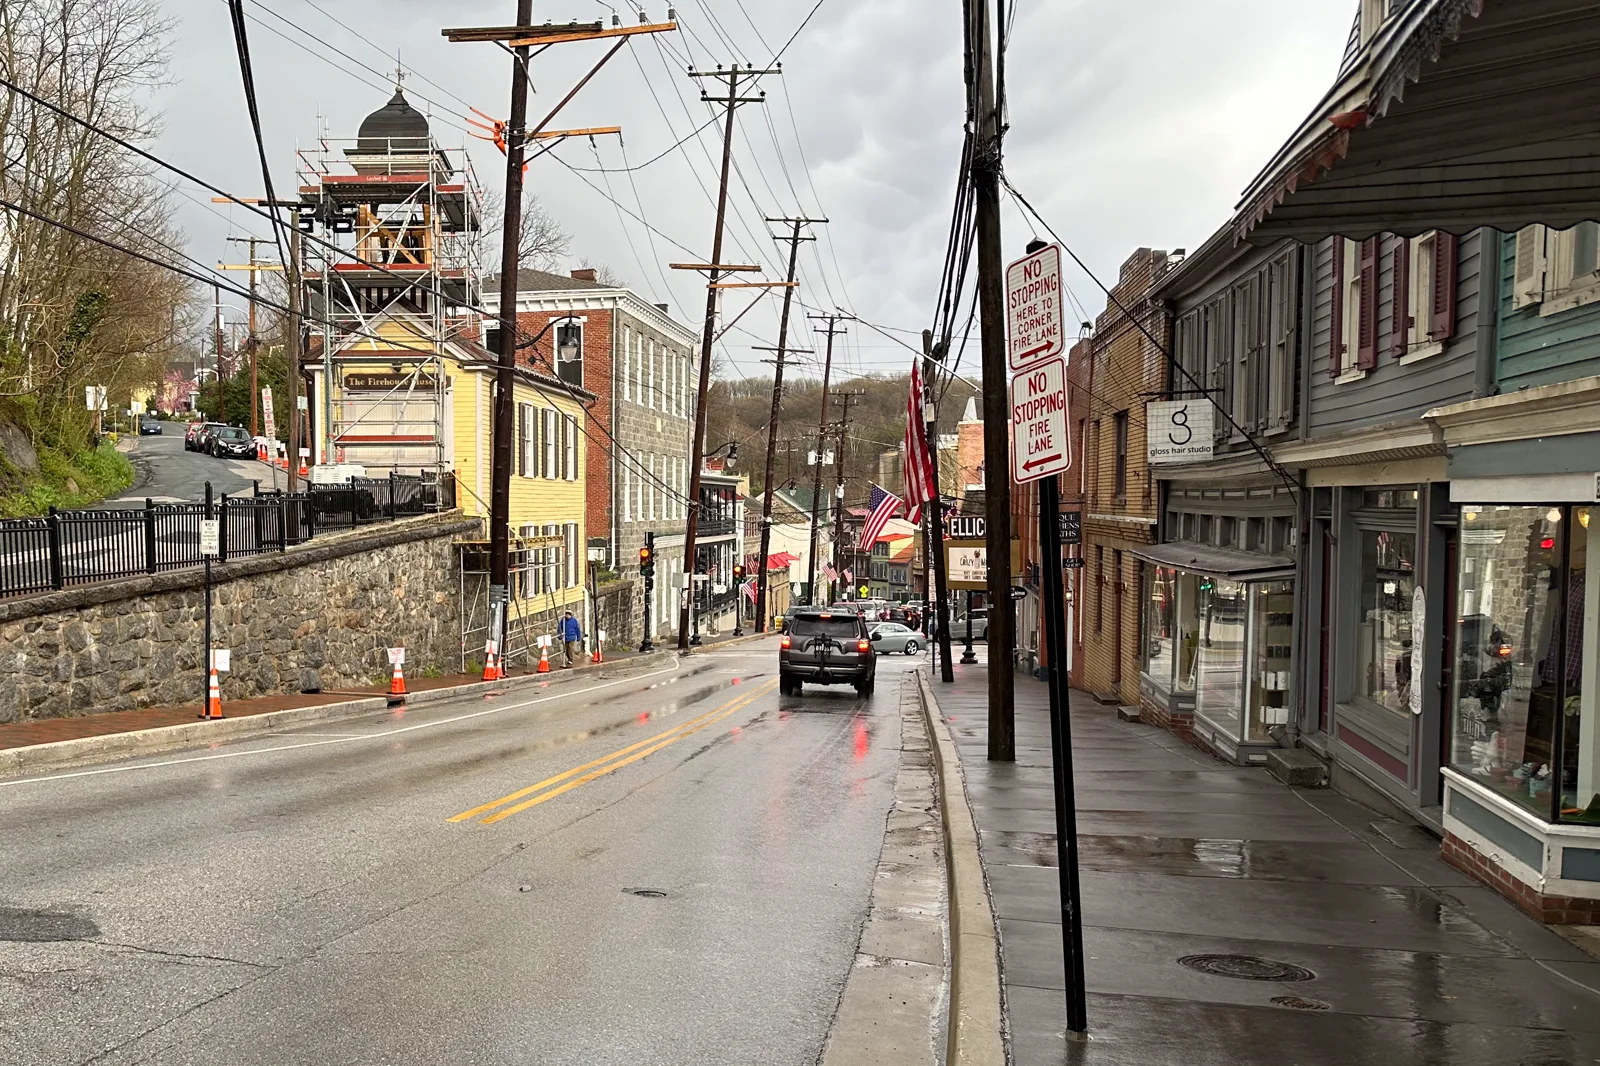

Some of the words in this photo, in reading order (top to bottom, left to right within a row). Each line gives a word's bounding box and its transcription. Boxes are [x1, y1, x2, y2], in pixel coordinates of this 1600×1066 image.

[1023, 259, 1042, 282] NO
[1011, 273, 1057, 309] STOPPING
[1016, 303, 1038, 322] HERE
[1042, 297, 1053, 312] TO
[1018, 312, 1053, 335] CORNER
[1013, 334, 1032, 351] FIRE
[1036, 323, 1058, 341] LANE
[348, 377, 365, 386] The
[1028, 372, 1047, 397] NO
[1015, 390, 1064, 425] STOPPING
[1029, 418, 1051, 438] FIRE
[1028, 434, 1053, 456] LANE
[1150, 447, 1170, 457] gloss
[1187, 445, 1211, 453] studio
[951, 517, 986, 536] ELLIC
[1059, 514, 1076, 522] QUE
